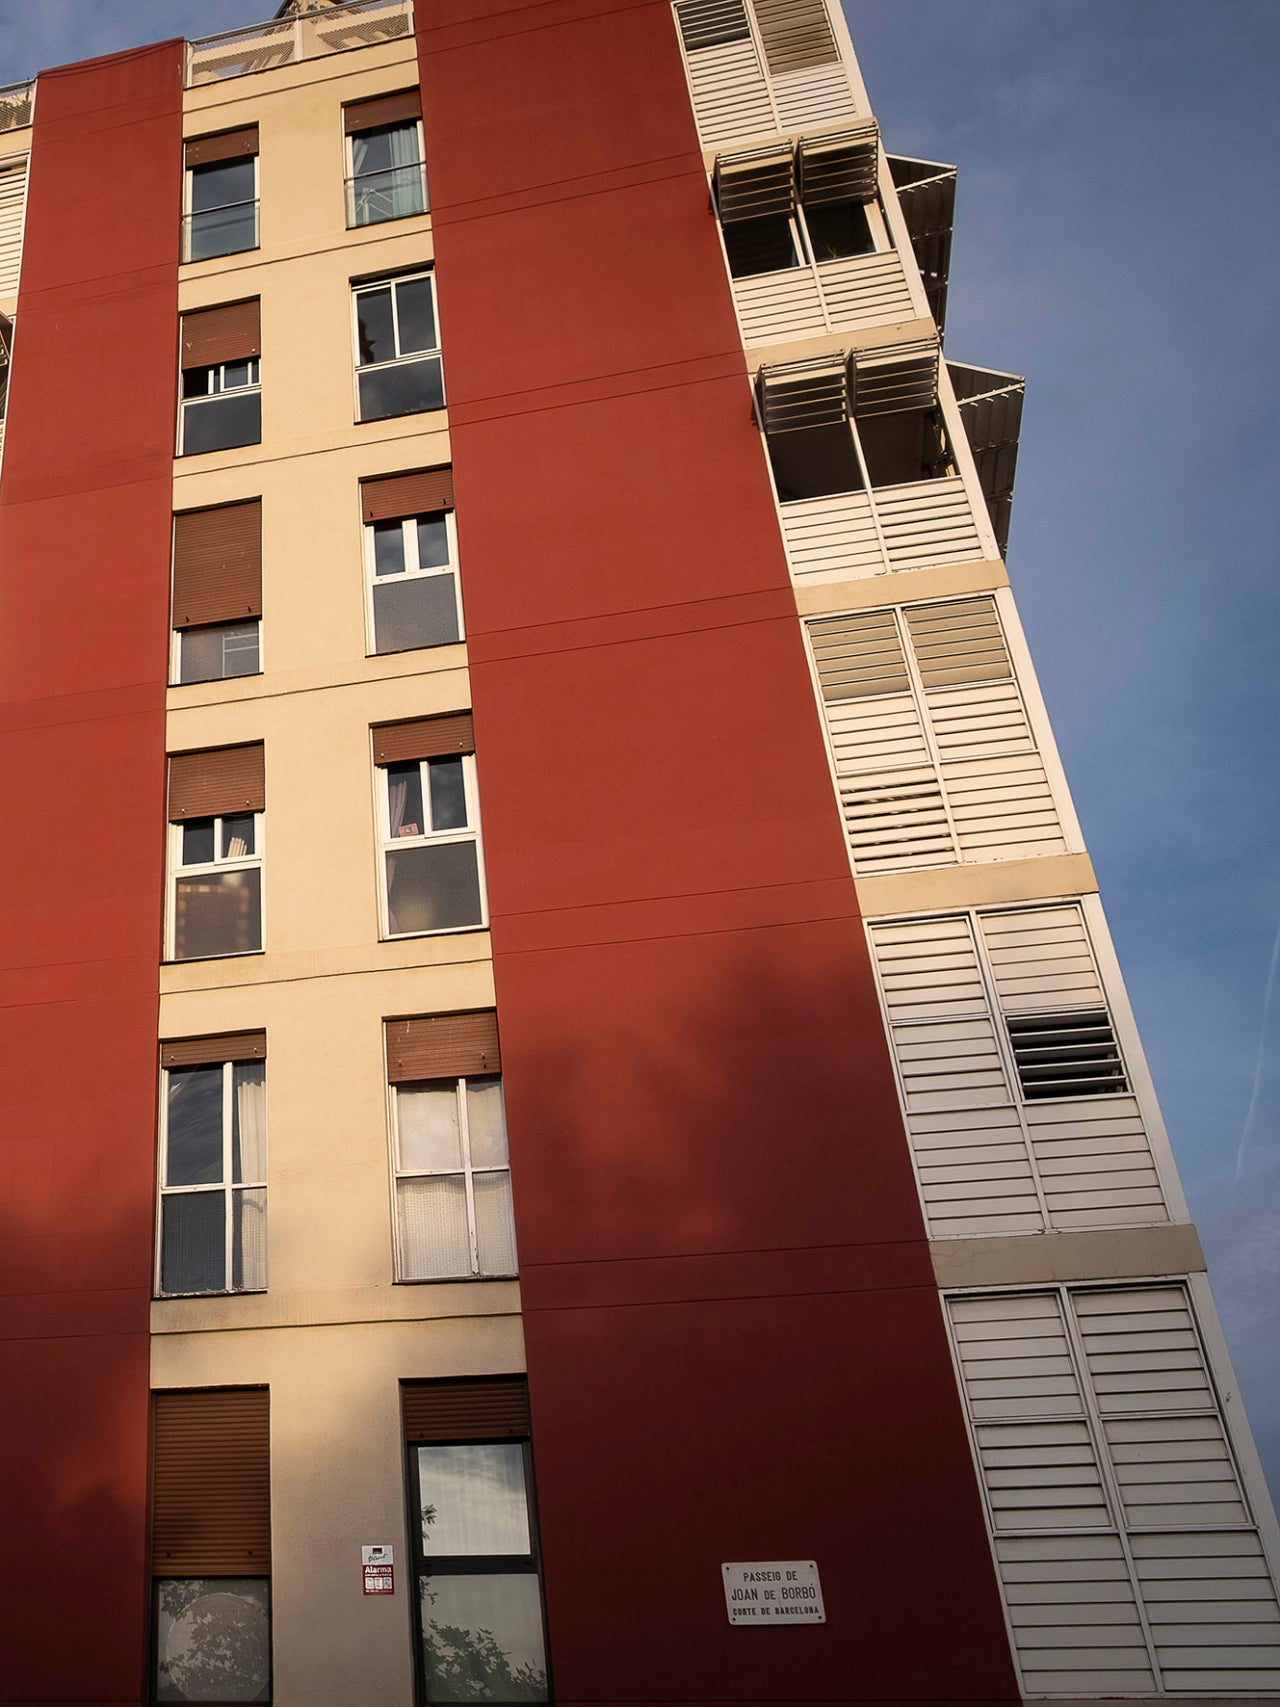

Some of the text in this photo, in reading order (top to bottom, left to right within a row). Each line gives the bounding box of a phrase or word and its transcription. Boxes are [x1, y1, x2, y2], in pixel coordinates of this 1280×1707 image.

[743, 1570, 798, 1582] PASSEIG DE
[732, 1588, 758, 1601] JOAN
[764, 1590, 776, 1600] DE
[761, 1607, 771, 1615] DE
[775, 1606, 819, 1615] BARCELONA
